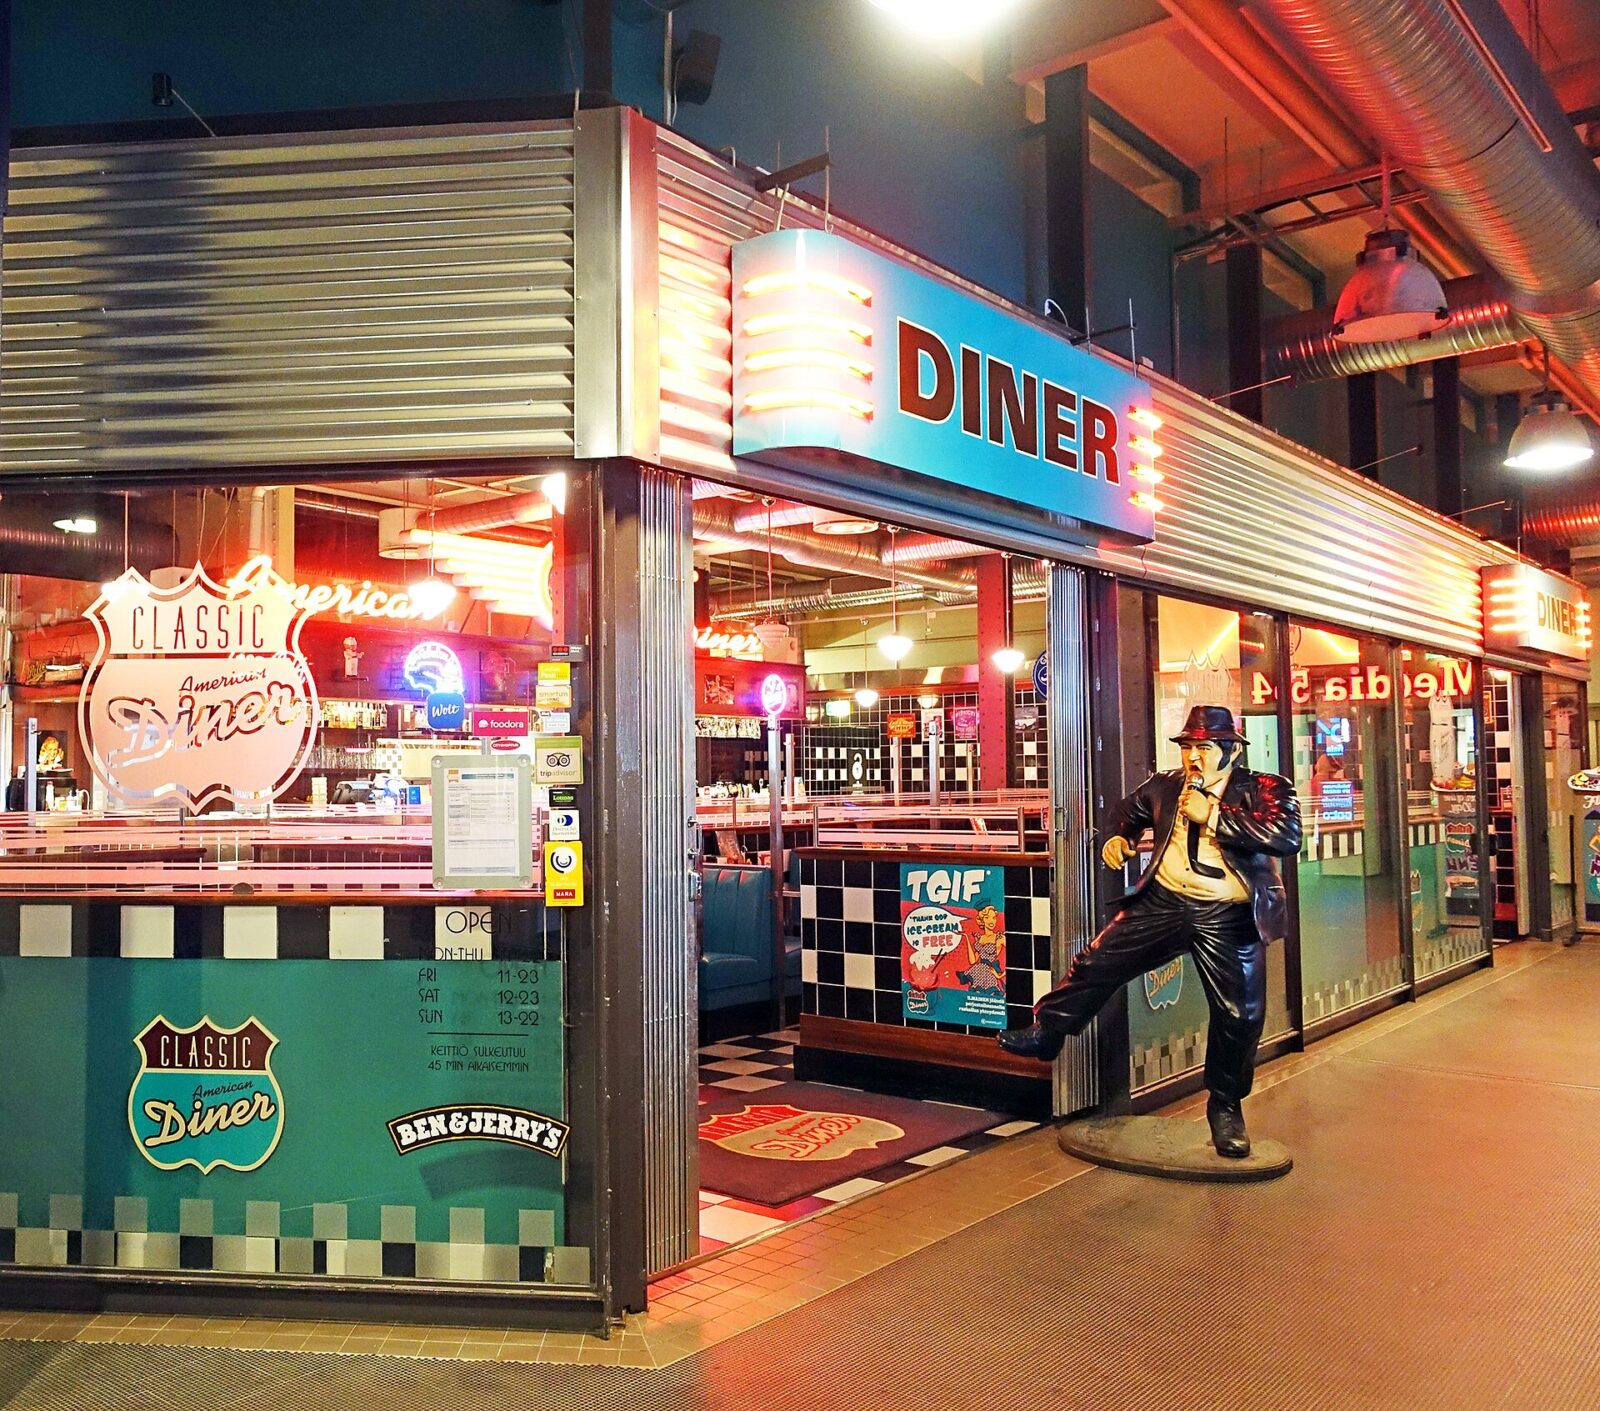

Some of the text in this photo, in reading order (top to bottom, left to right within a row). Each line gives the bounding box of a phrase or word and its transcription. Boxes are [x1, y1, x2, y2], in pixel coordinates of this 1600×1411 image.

[897, 316, 1120, 486] DINER
[1537, 591, 1577, 636] DINER
[132, 604, 264, 650] CLASSIC
[432, 703, 460, 718] Wolt
[107, 680, 303, 769] Diner
[490, 719, 524, 729] foodora
[540, 769, 577, 778] tripadvisor
[907, 870, 985, 904] TGIF
[445, 911, 512, 934] OPEN
[907, 923, 959, 936] ICE-CREAM
[922, 935, 953, 948] FREE
[418, 968, 539, 984] FRI 11-23
[418, 988, 540, 1005] SAT 12-23
[418, 1009, 539, 1026] SUN 13-22
[161, 1035, 251, 1068] CLASSIC
[431, 1043, 526, 1057] KEITTIÖ SULKEUTUU
[428, 1060, 529, 1072] 45 MIN AIKAISEMMIN
[192, 1079, 253, 1100] American
[143, 1091, 276, 1147] Diner
[751, 1115, 862, 1159] Diner
